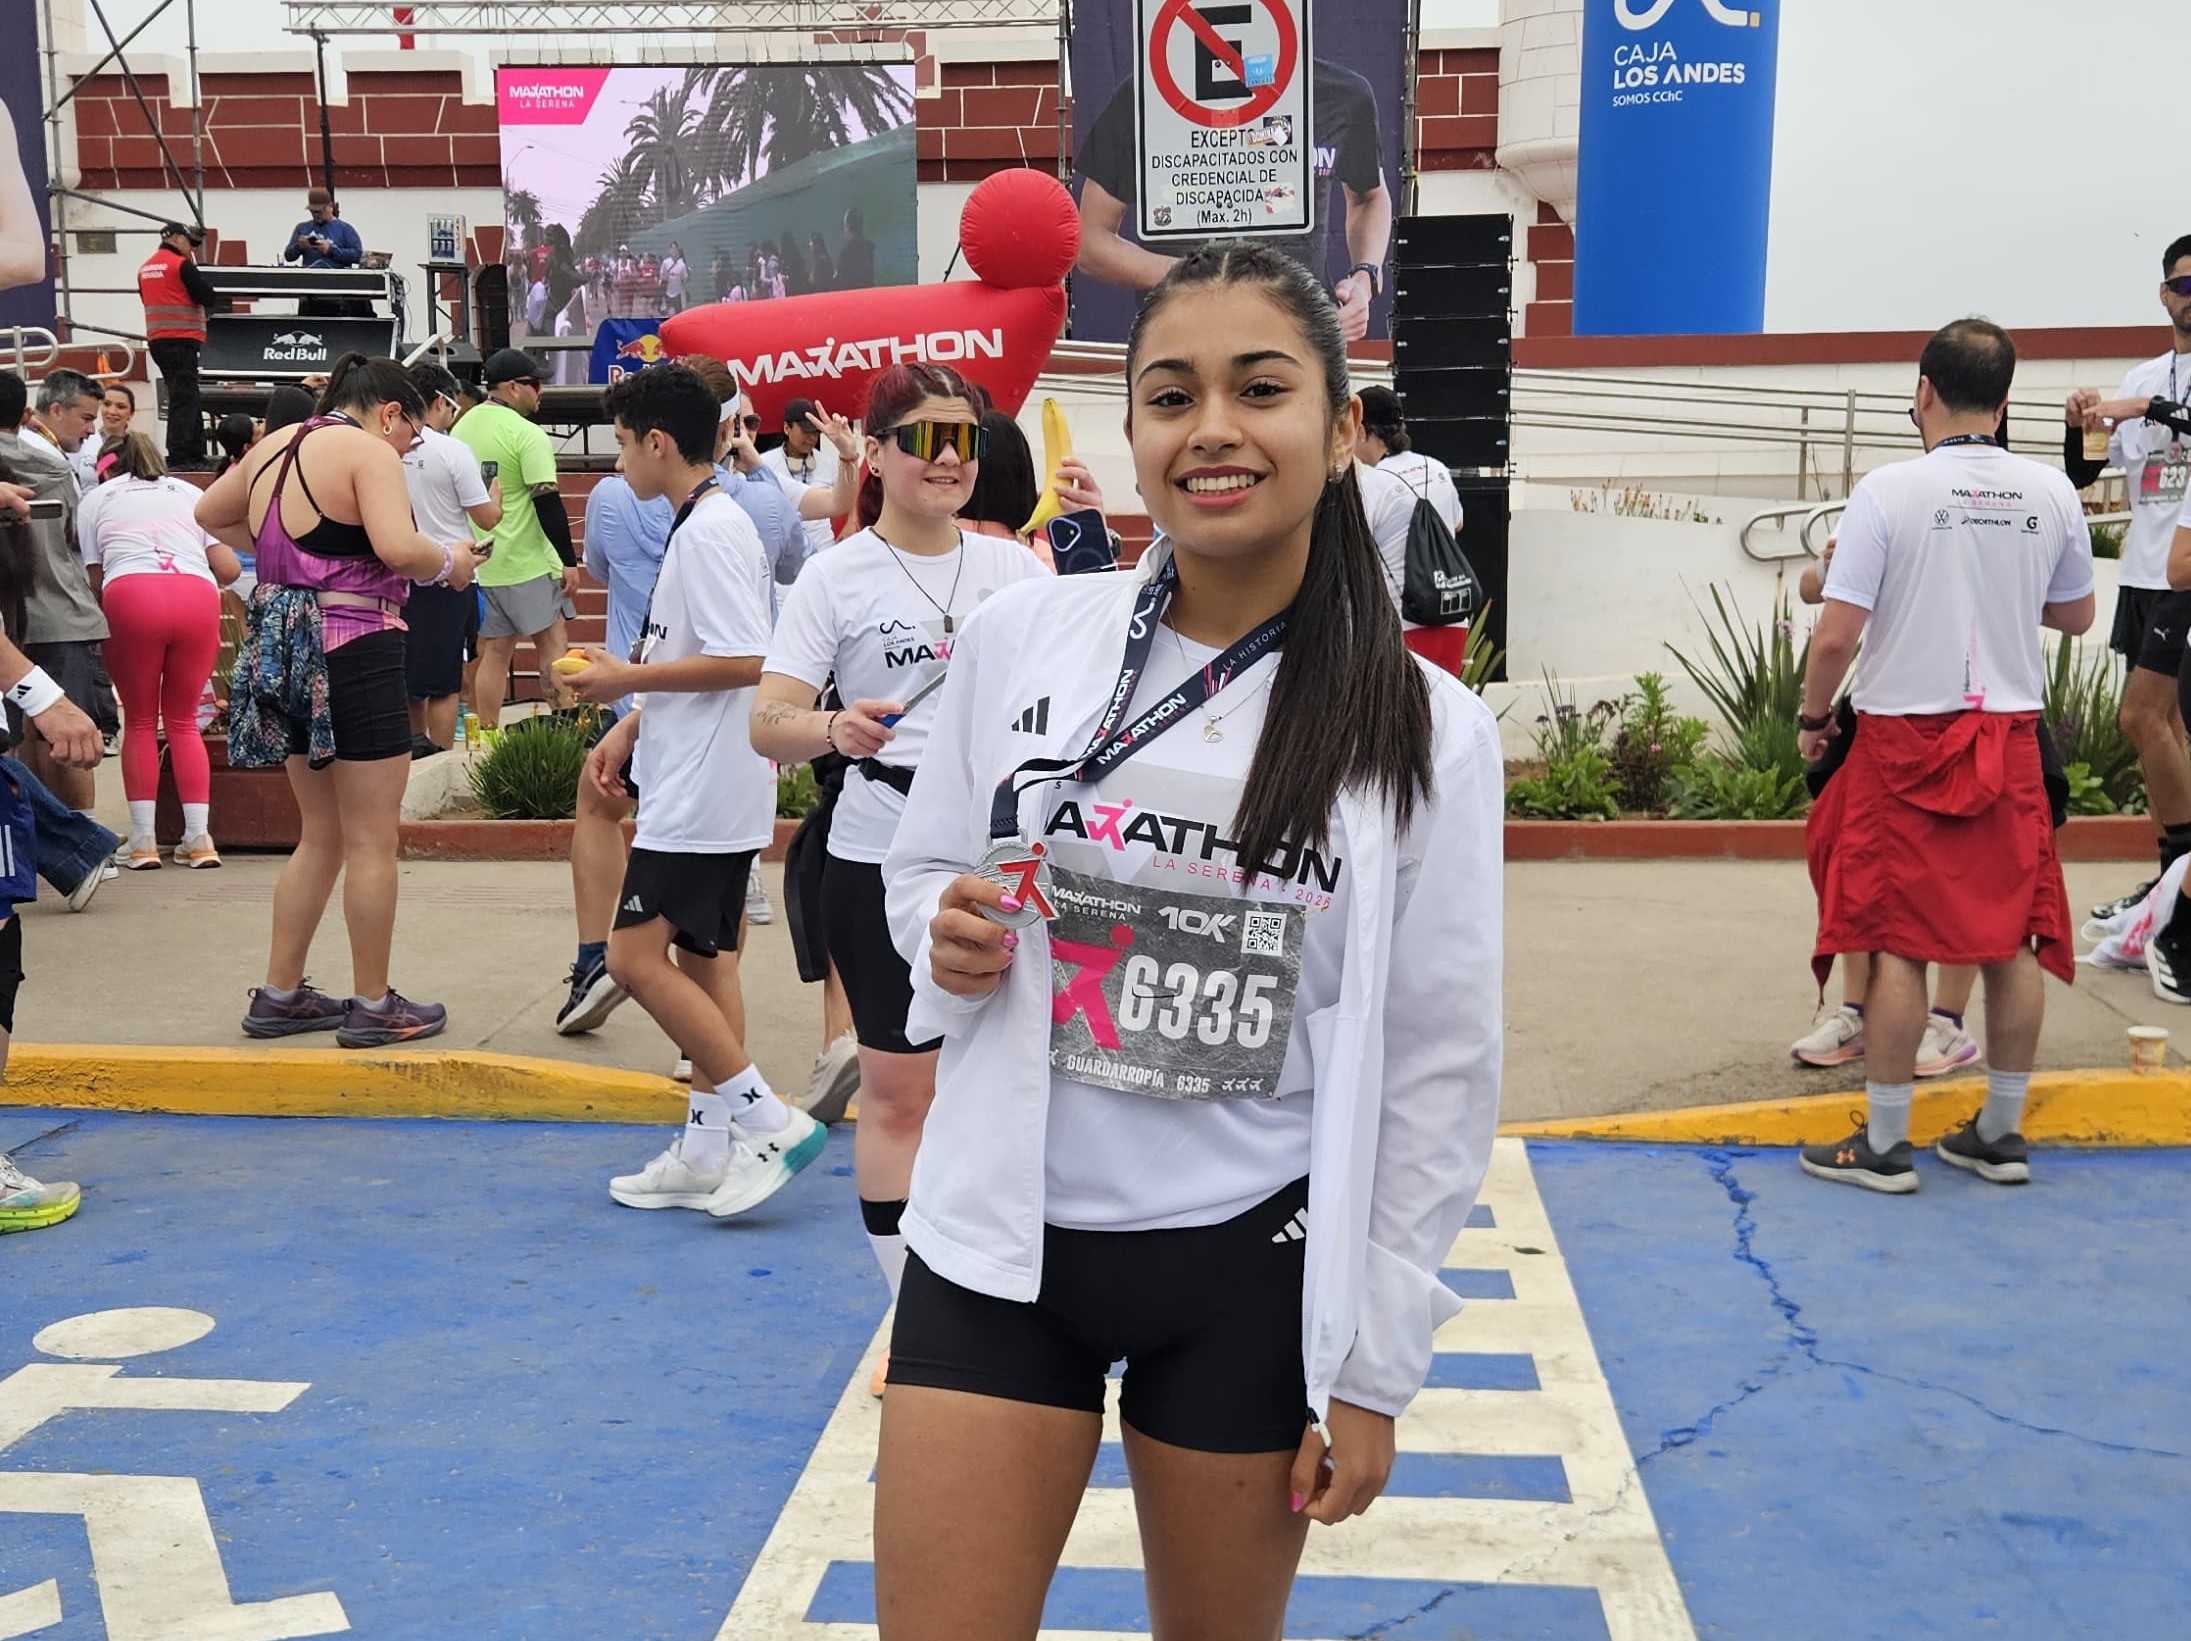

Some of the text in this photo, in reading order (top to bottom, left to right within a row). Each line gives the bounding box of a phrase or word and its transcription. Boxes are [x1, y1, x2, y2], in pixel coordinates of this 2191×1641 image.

[1614, 41, 1677, 66] CAJA
[1613, 62, 1746, 90] LOS ANDES
[520, 100, 575, 109] LA SERENA
[1612, 90, 1684, 107] SOMOS CChC
[1152, 151, 1265, 169] DISCAPACITADOS
[1269, 149, 1297, 164] CON
[1171, 168, 1277, 187] CREDENCIAL DE
[1196, 207, 1252, 225] (Max. 2h)
[263, 347, 327, 361] Red Bull
[1151, 855, 1177, 871] LA
[1073, 905, 1127, 920] SERENA
[1158, 906, 1238, 943] 10K
[1118, 955, 1279, 1048] 6335
[1066, 1053, 1211, 1093] GUARDARROPÍA 6335
